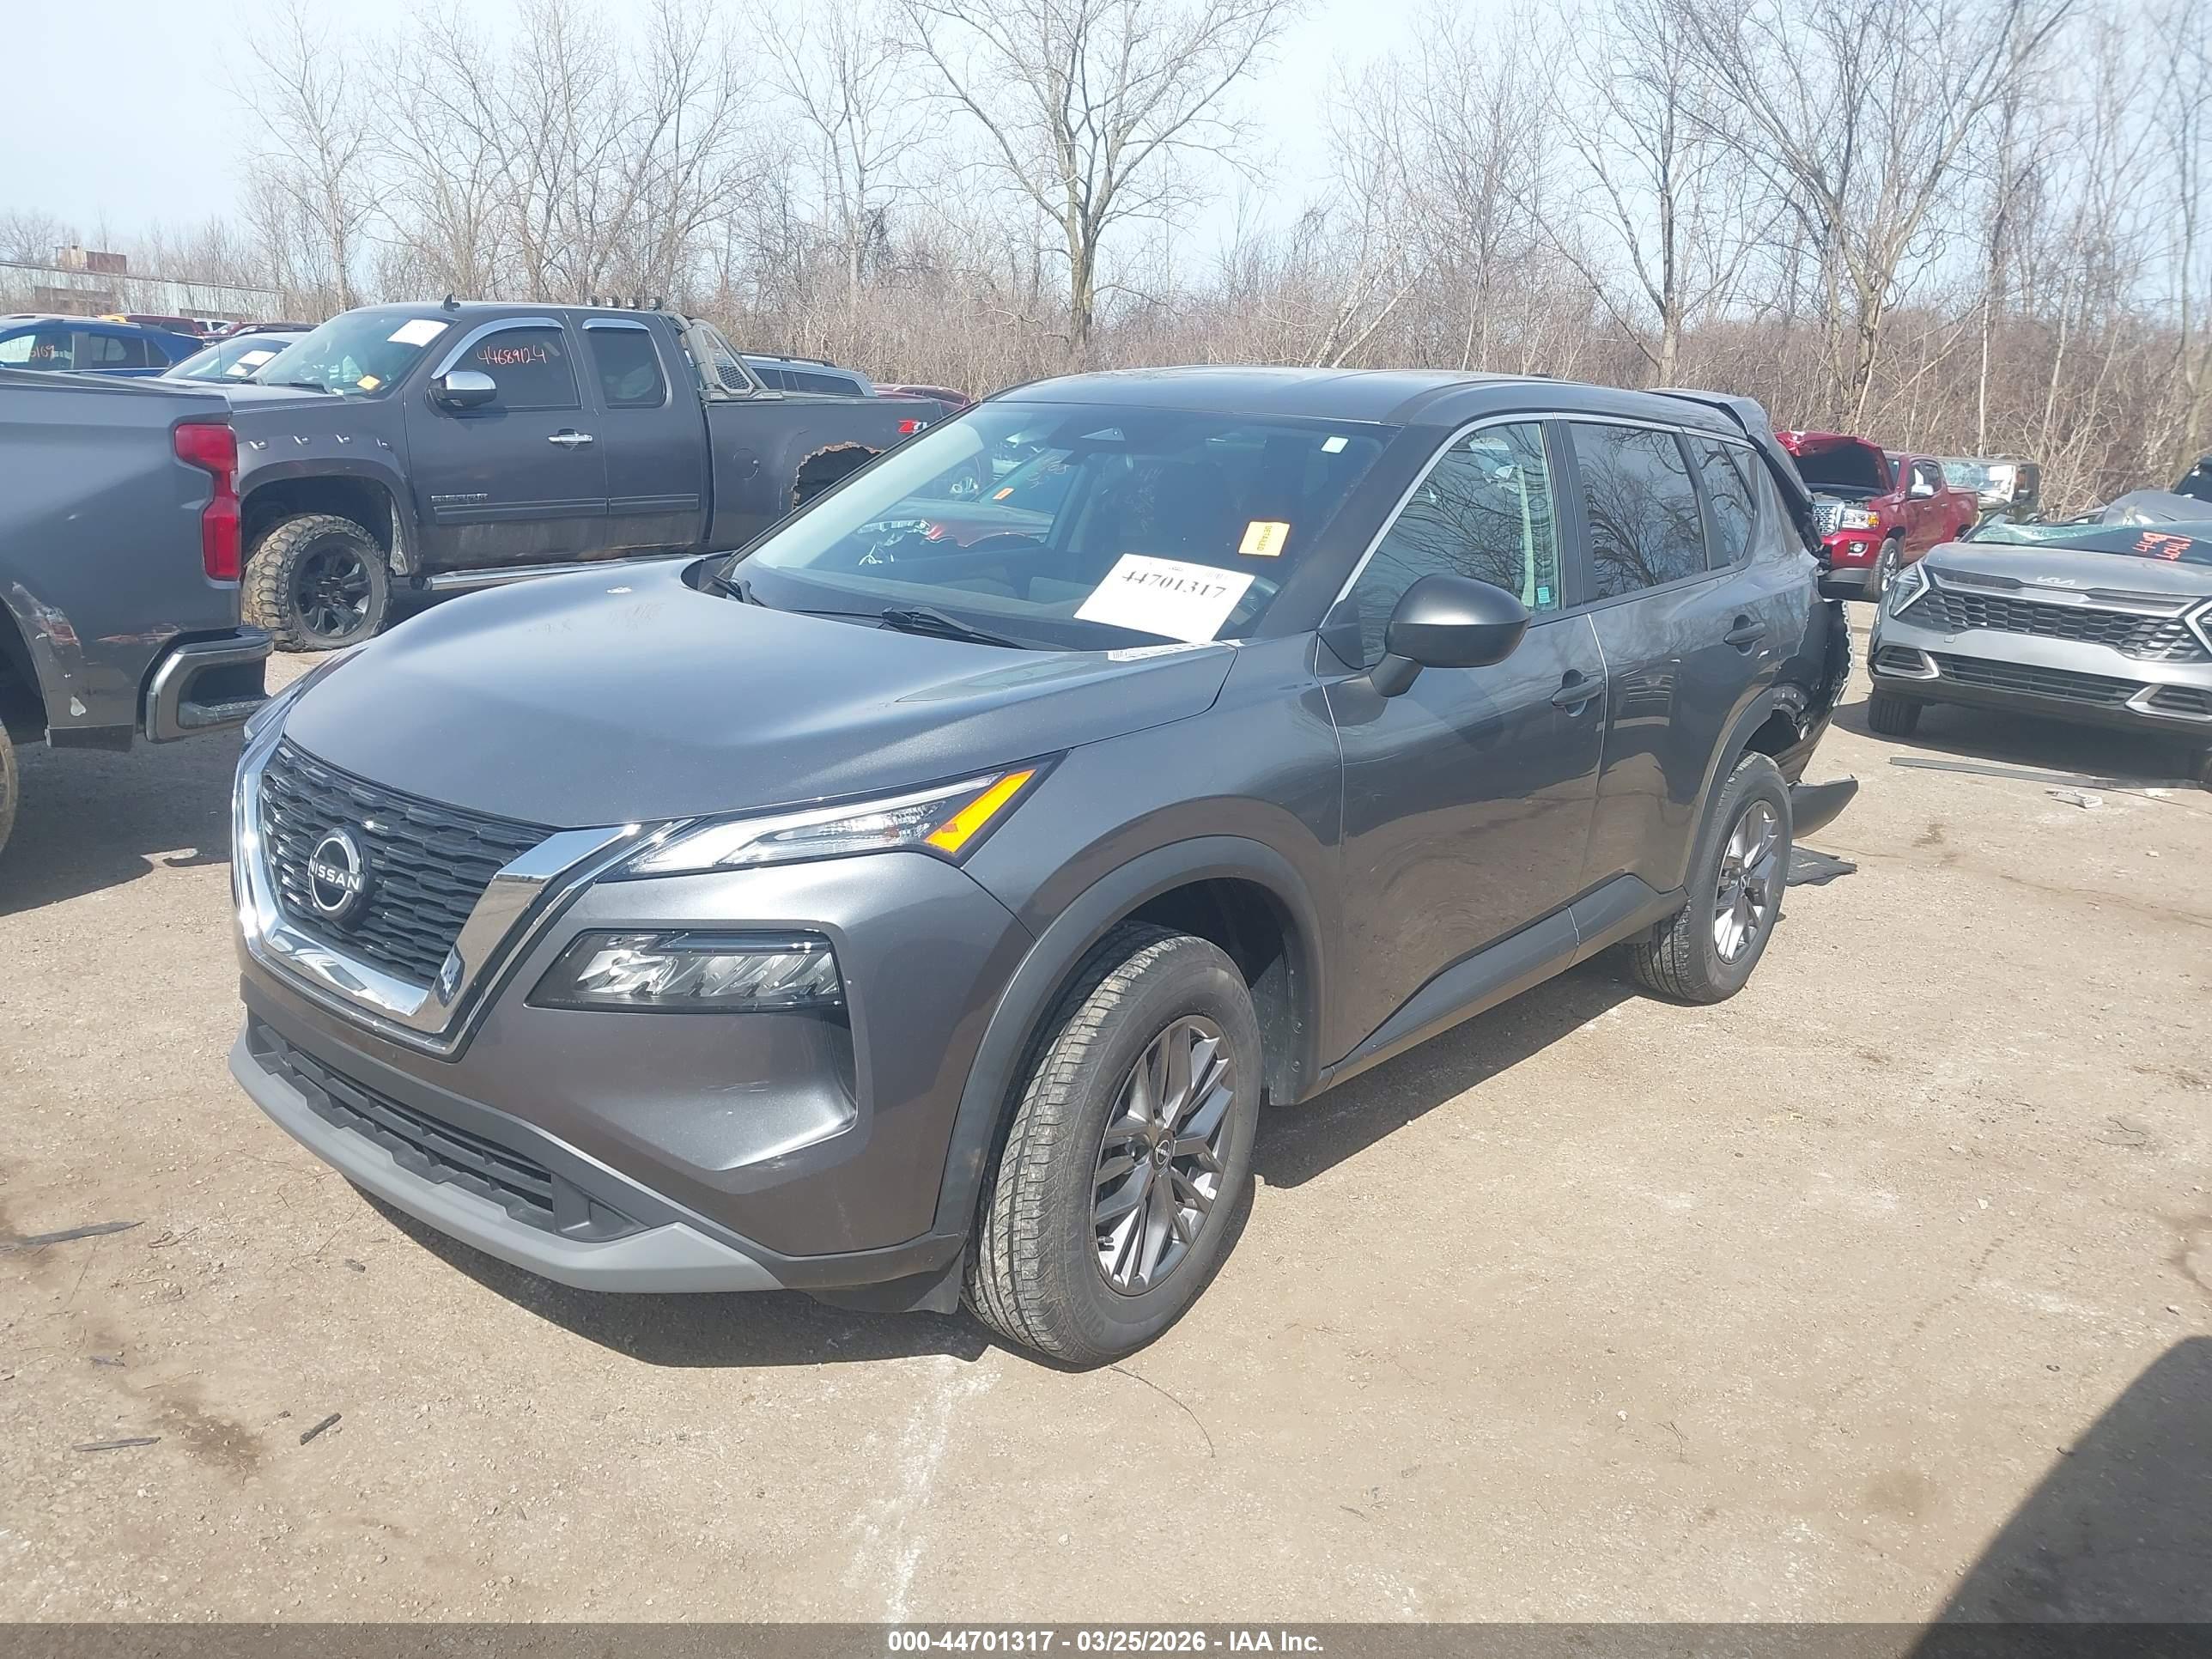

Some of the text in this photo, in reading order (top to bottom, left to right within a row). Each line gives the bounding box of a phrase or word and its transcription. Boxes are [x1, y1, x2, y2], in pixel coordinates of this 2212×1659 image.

[477, 345, 547, 364] 44689124
[1122, 570, 1226, 599] 44701317
[308, 859, 361, 890] NISSAN
